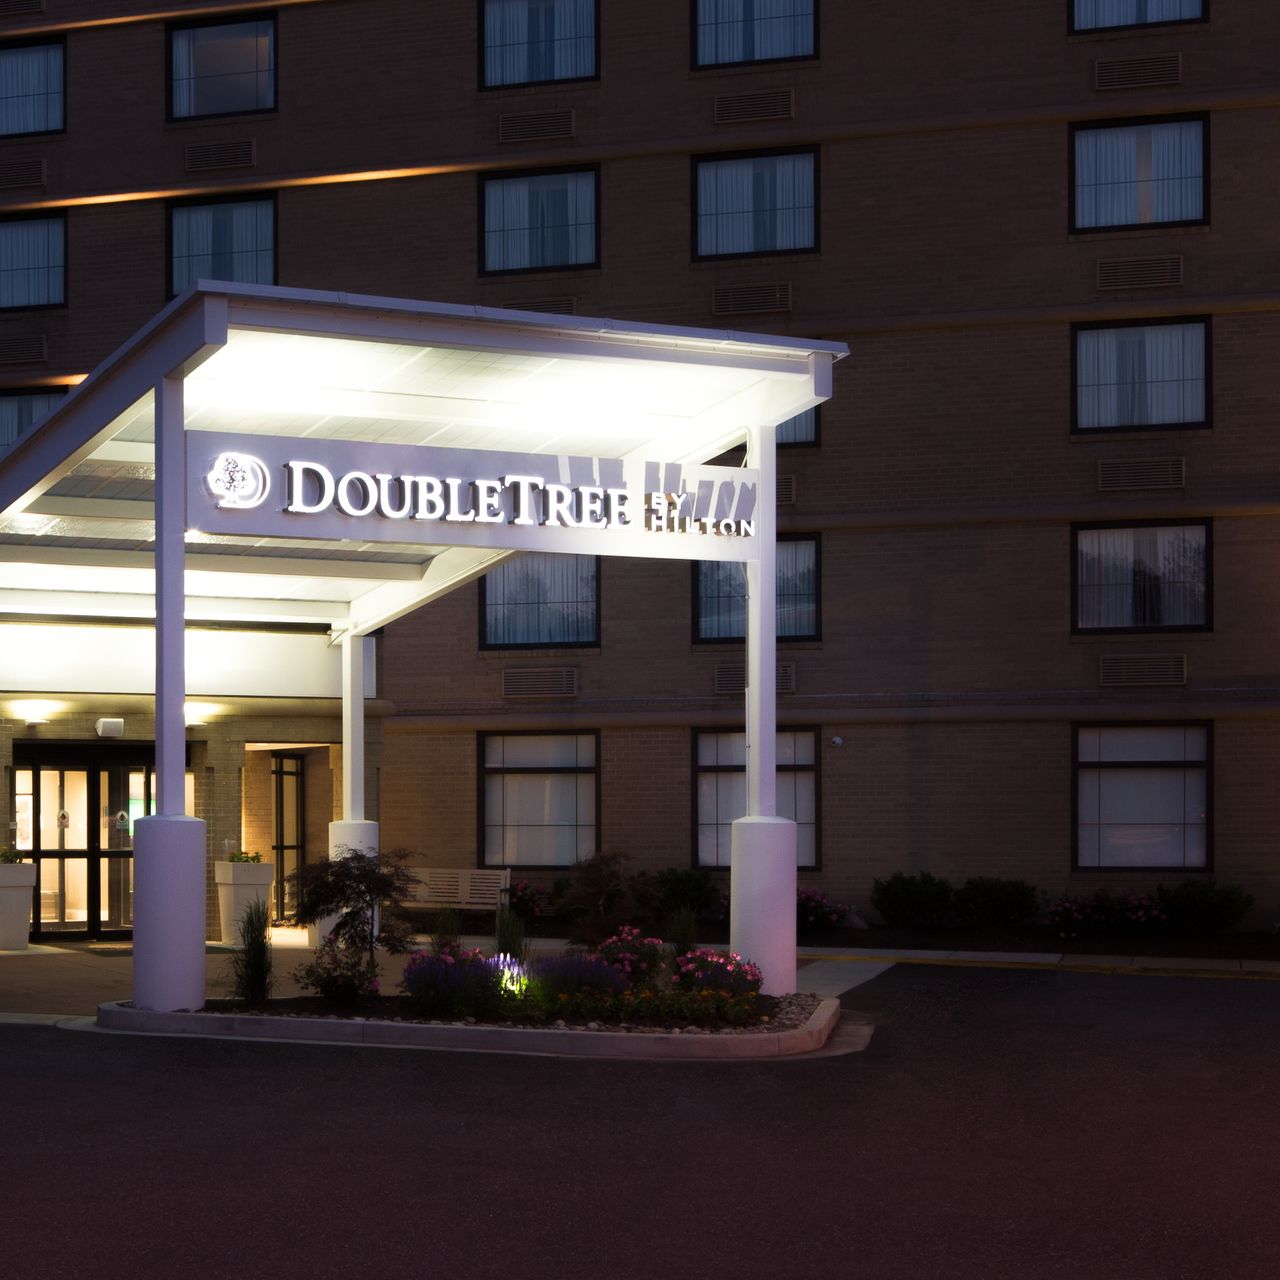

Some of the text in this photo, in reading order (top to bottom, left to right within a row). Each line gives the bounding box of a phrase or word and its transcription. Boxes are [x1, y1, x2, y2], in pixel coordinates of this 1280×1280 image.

[287, 460, 632, 529] DOUBLETREE
[651, 491, 687, 511] BY
[651, 514, 756, 537] HILTON
